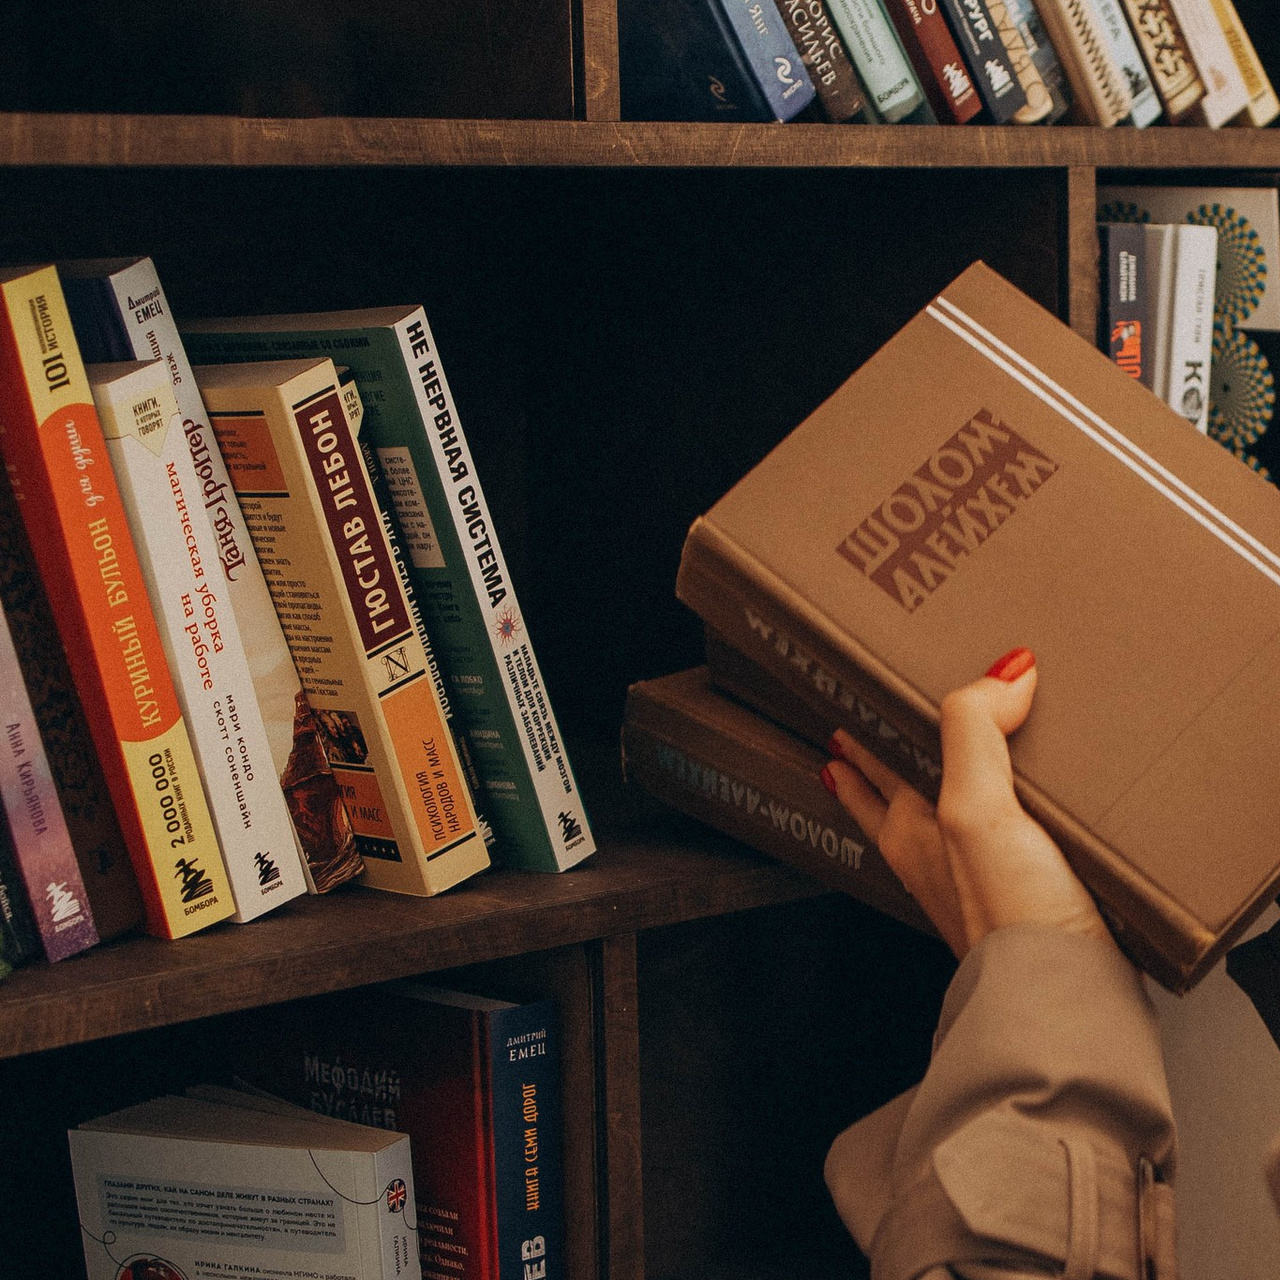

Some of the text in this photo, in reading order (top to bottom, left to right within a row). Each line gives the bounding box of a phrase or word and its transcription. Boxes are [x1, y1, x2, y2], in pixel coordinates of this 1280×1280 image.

[747, 3, 770, 36] Янг
[35, 294, 59, 350] ИСТОРИЯ
[136, 300, 163, 324] ЕМЕЦ
[139, 418, 163, 436] ГОВОРЯТ
[405, 320, 509, 608] НЕ НЕРВНАЯ СИСТЕМА
[164, 461, 227, 654] магическая уборка
[307, 408, 396, 633] ГЮСТАВ ЛЕБОН
[878, 435, 1060, 613] АЛЕЙХЕМ
[61, 415, 162, 728] КУРИНЫЙ БУЛЬОН для души
[180, 593, 217, 691] на работе
[223, 694, 255, 782] мари кондо
[502, 653, 546, 772] РАЗЛИЧНЫХ ЗАБОЛЕВАНИЙ
[518, 644, 572, 793] НАЛАДЬТЕ СВЯЗЬ МЕЖДУ МОЗГОМ
[163, 747, 177, 774] РОССИИ
[172, 783, 184, 801] КНИГ
[212, 700, 254, 829] скотт соненшайн
[422, 737, 462, 833] НАРОДОВ И МАСС
[147, 752, 185, 849] 2 000 000
[177, 801, 195, 842] ПРОДАННЫХ
[415, 770, 446, 841] ПСИХОЛОГИЯ
[182, 895, 219, 915] БОМБОРА
[507, 1028, 548, 1048] ДМИТРИЙ
[510, 1043, 546, 1062] ЕМЕЦ
[521, 1083, 540, 1210] КНИГА СЕМИ ДОРОГ
[392, 1235, 402, 1275] ГАЛКИНА
[401, 1236, 409, 1266] ИРИНА
